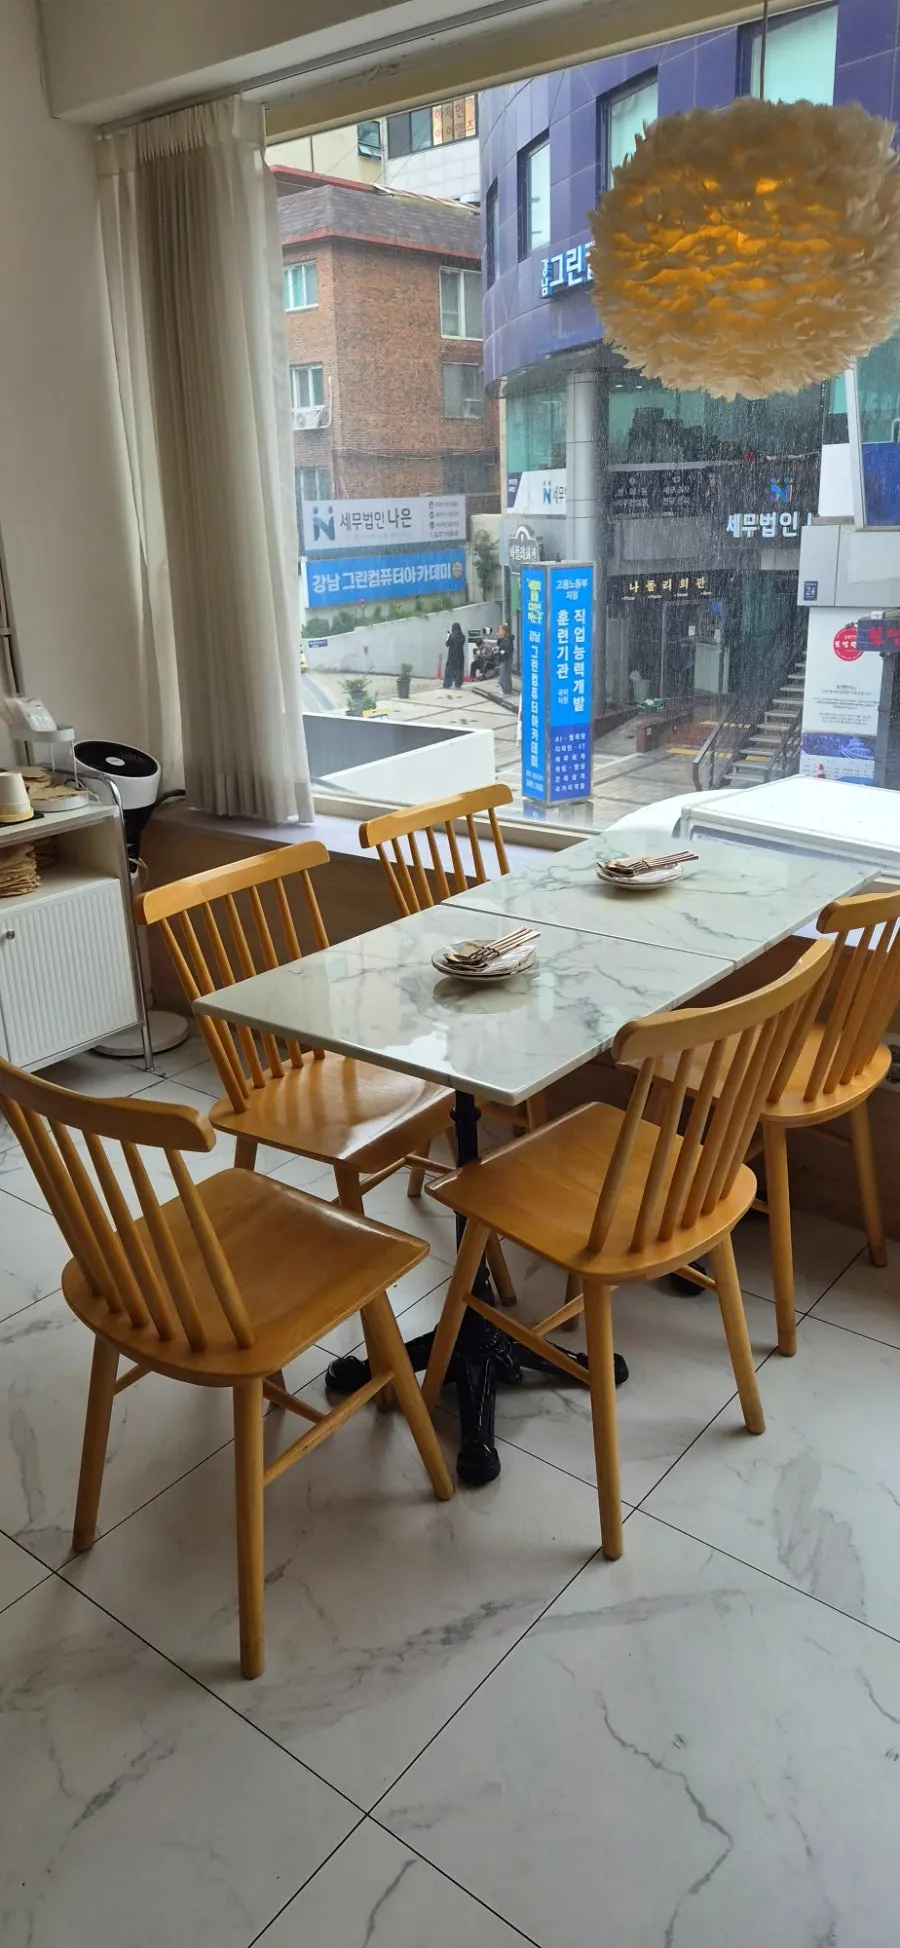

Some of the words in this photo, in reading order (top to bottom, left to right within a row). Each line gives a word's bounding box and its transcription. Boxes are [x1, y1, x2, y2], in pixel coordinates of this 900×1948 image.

[340, 511, 385, 531] 세무법인
[388, 507, 412, 529] 나은
[726, 511, 799, 538] 세무법인
[312, 573, 341, 594] 강남
[342, 562, 450, 590] 그린컴퓨터아카데미
[556, 578, 588, 590] 고용노동부
[565, 590, 578, 600] 지정
[805, 586, 816, 596] 24
[556, 608, 570, 680] 훈련기관
[572, 608, 587, 713] 직업능력개발
